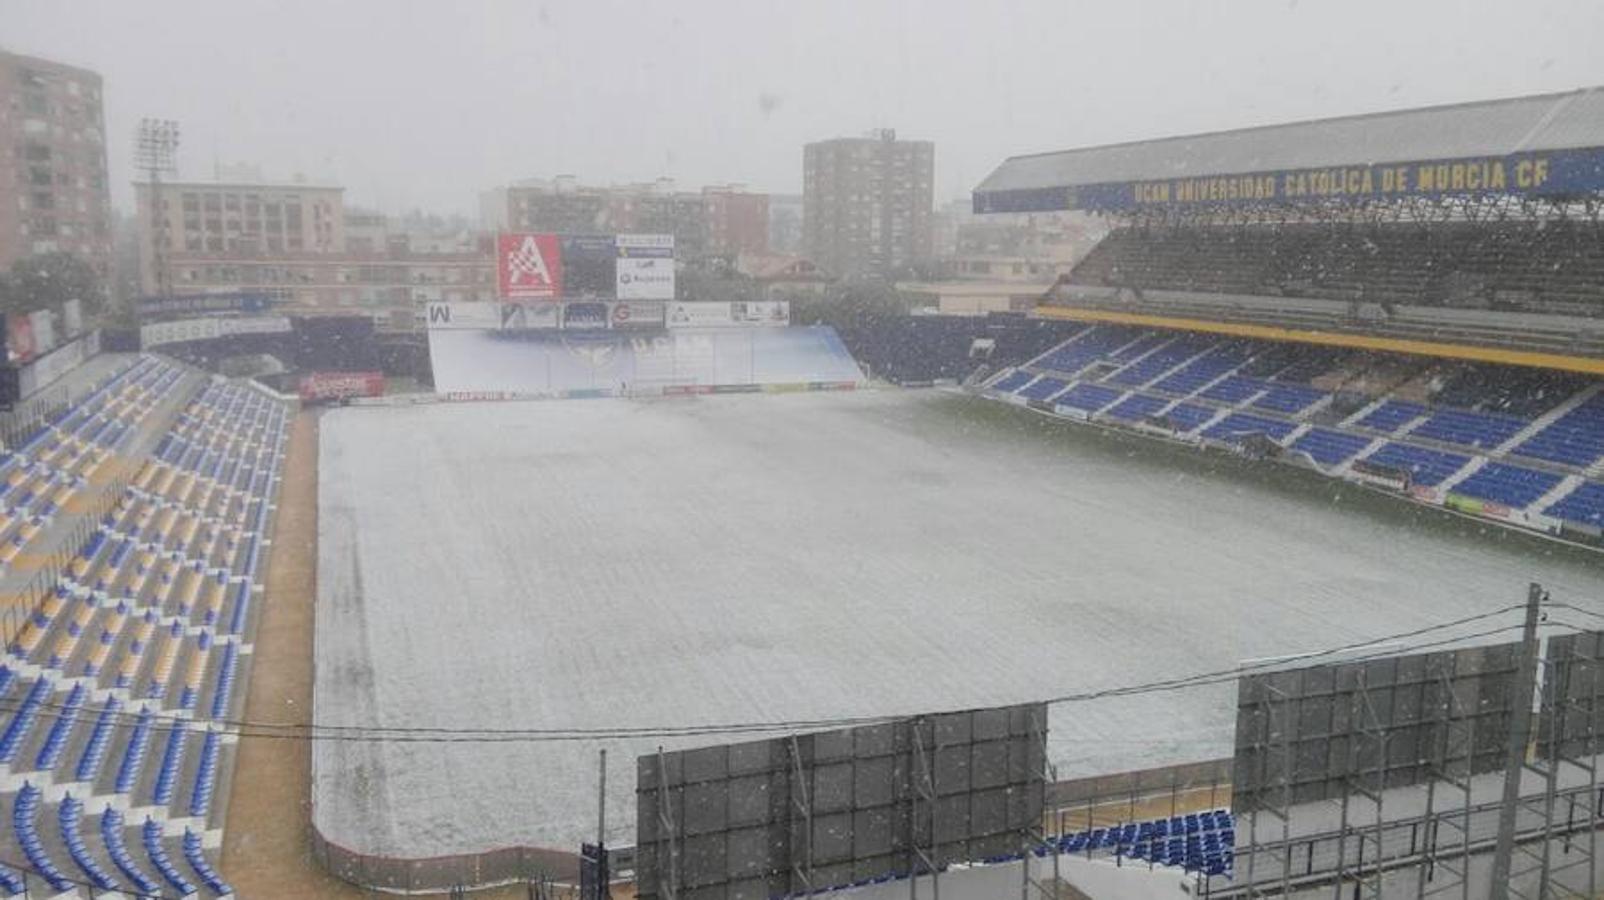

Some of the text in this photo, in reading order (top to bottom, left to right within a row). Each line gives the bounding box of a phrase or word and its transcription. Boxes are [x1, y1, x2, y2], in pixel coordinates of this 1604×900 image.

[1135, 184, 1168, 201] UCAM
[1176, 178, 1274, 200] UNIVERSIDAD
[1382, 168, 1407, 192] DE
[1418, 162, 1505, 191] MURCIA
[1517, 160, 1547, 186] CF
